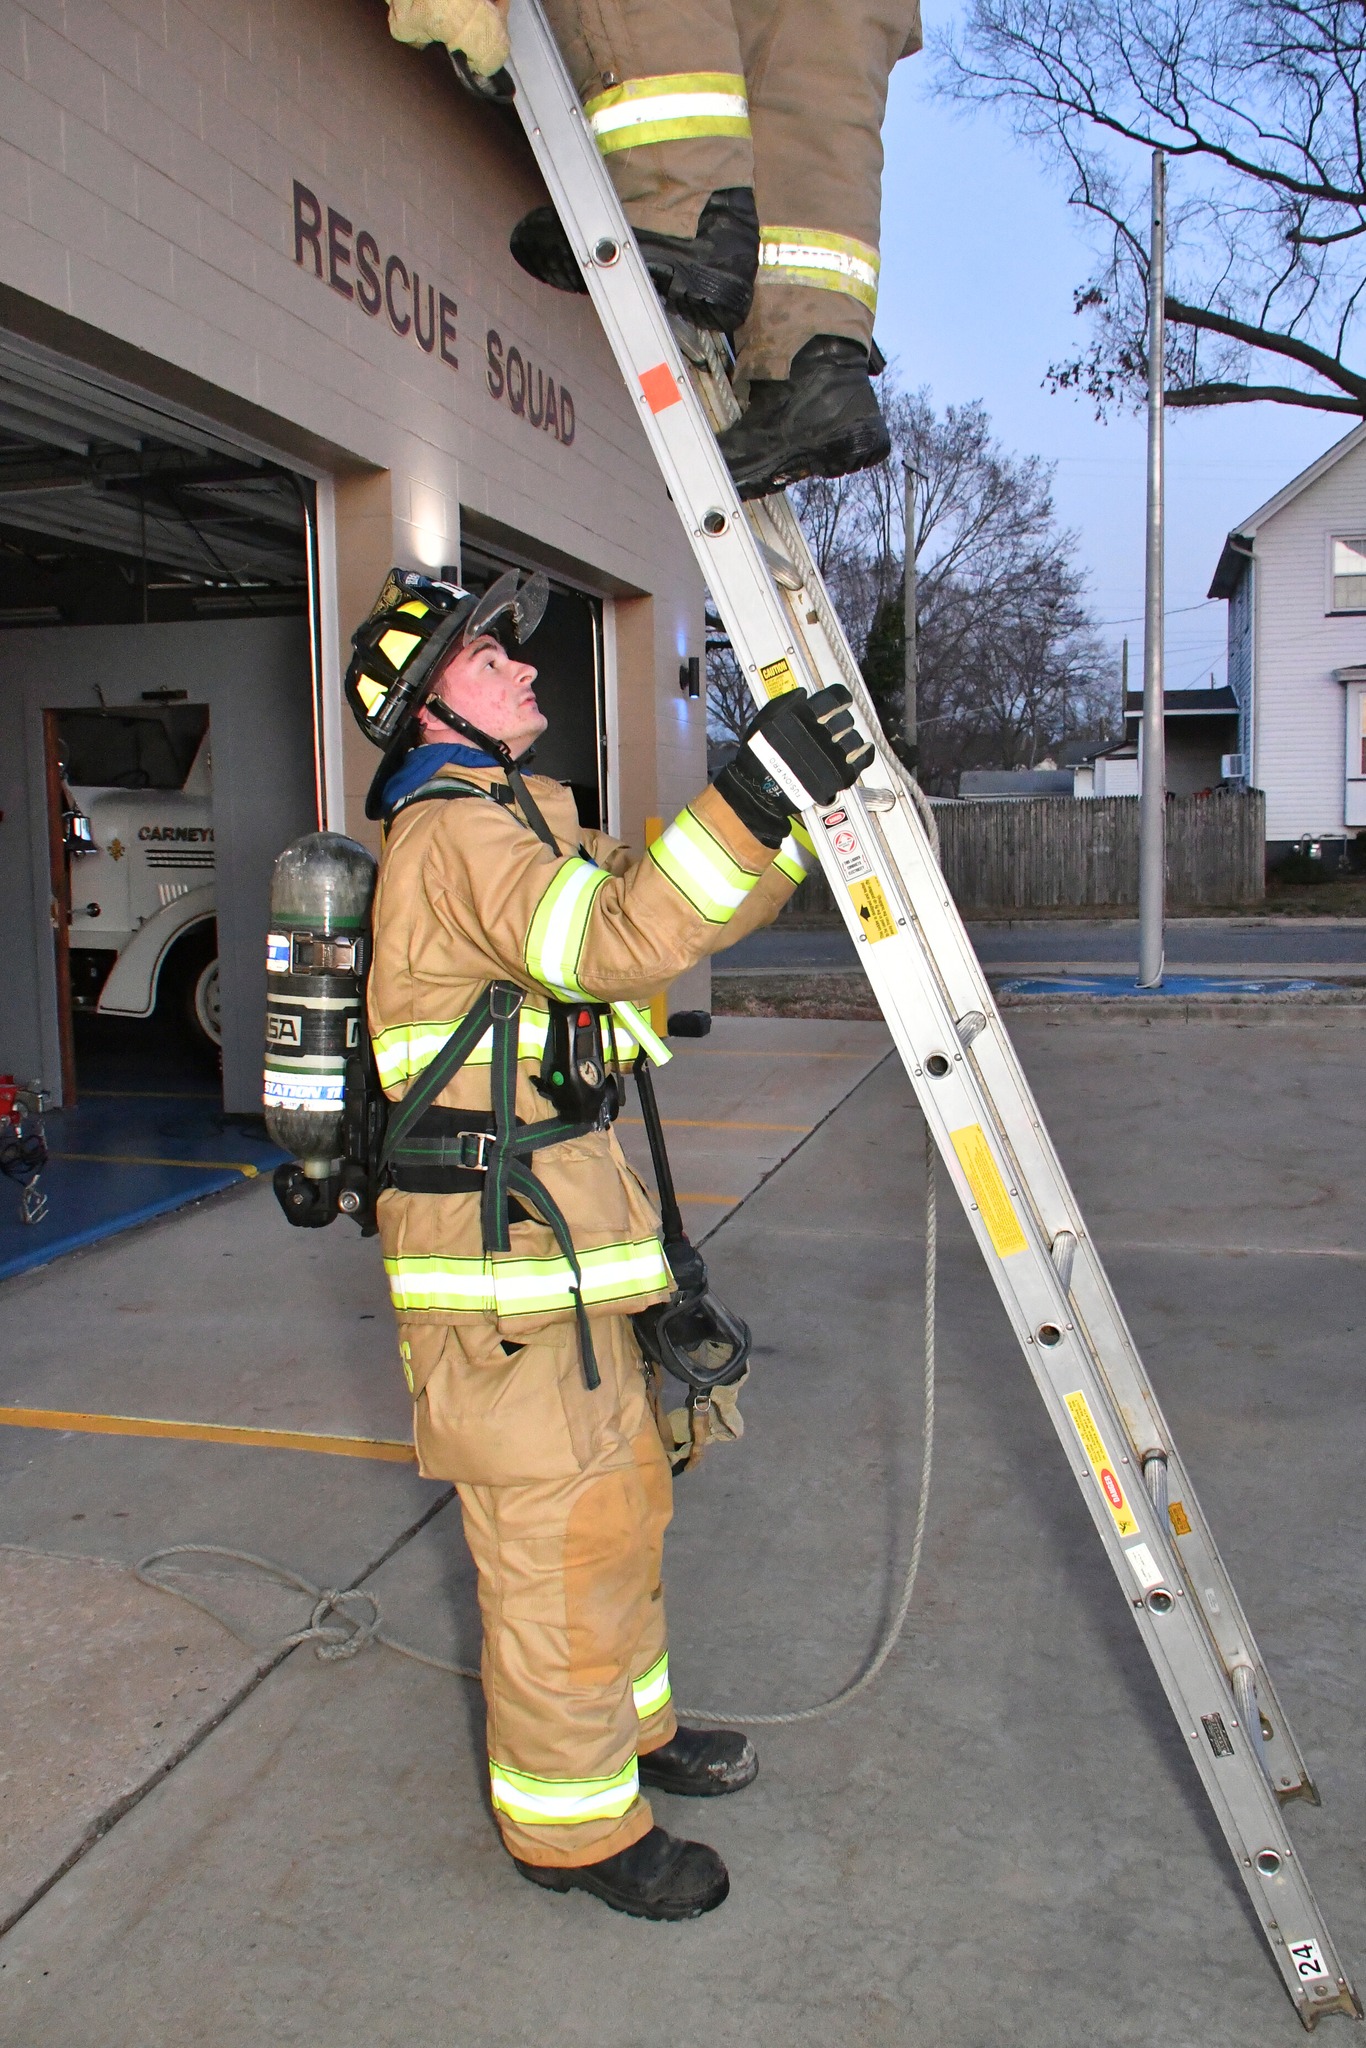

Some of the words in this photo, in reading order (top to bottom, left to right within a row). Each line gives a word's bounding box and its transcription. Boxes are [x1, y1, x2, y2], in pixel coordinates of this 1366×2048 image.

[293, 178, 458, 370] RESCUE
[485, 329, 575, 446] SQUAD
[762, 660, 788, 679] CAUTION
[770, 758, 782, 773] PRO
[764, 776, 783, 797] TECH
[782, 773, 801, 798] FUSION
[269, 1017, 298, 1041] SA
[264, 1082, 322, 1099] STATION
[1103, 1474, 1121, 1503] DANGER
[1292, 1944, 1321, 1975] 24
